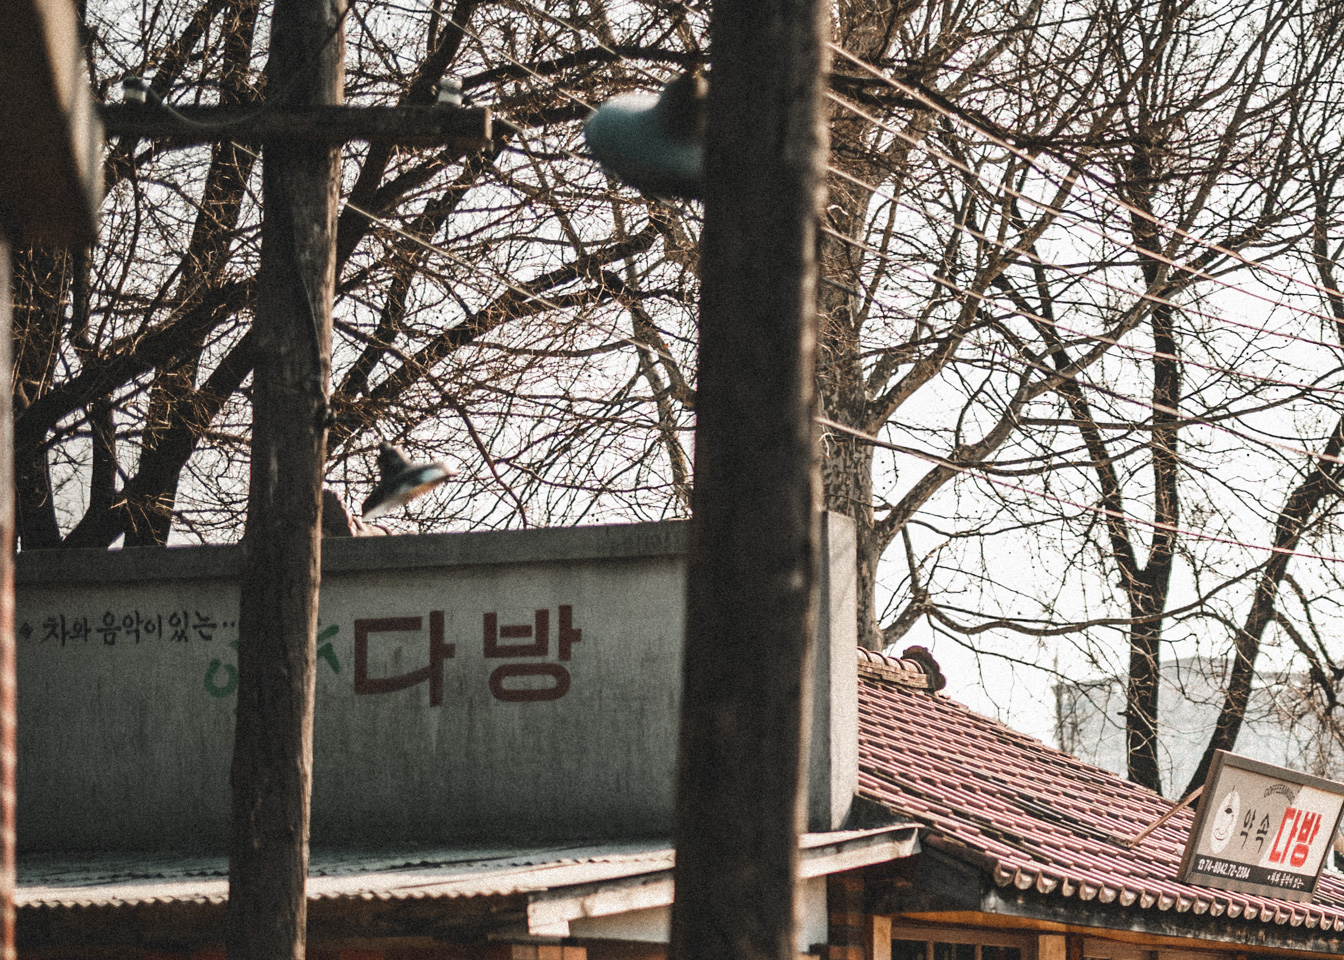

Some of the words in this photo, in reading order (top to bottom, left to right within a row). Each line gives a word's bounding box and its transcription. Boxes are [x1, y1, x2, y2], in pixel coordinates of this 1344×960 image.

[41, 613, 92, 647] 차와
[97, 610, 164, 646] 음악이
[352, 604, 583, 707] 다방
[1239, 808, 1271, 854] 약속
[1268, 806, 1323, 868] 다방
